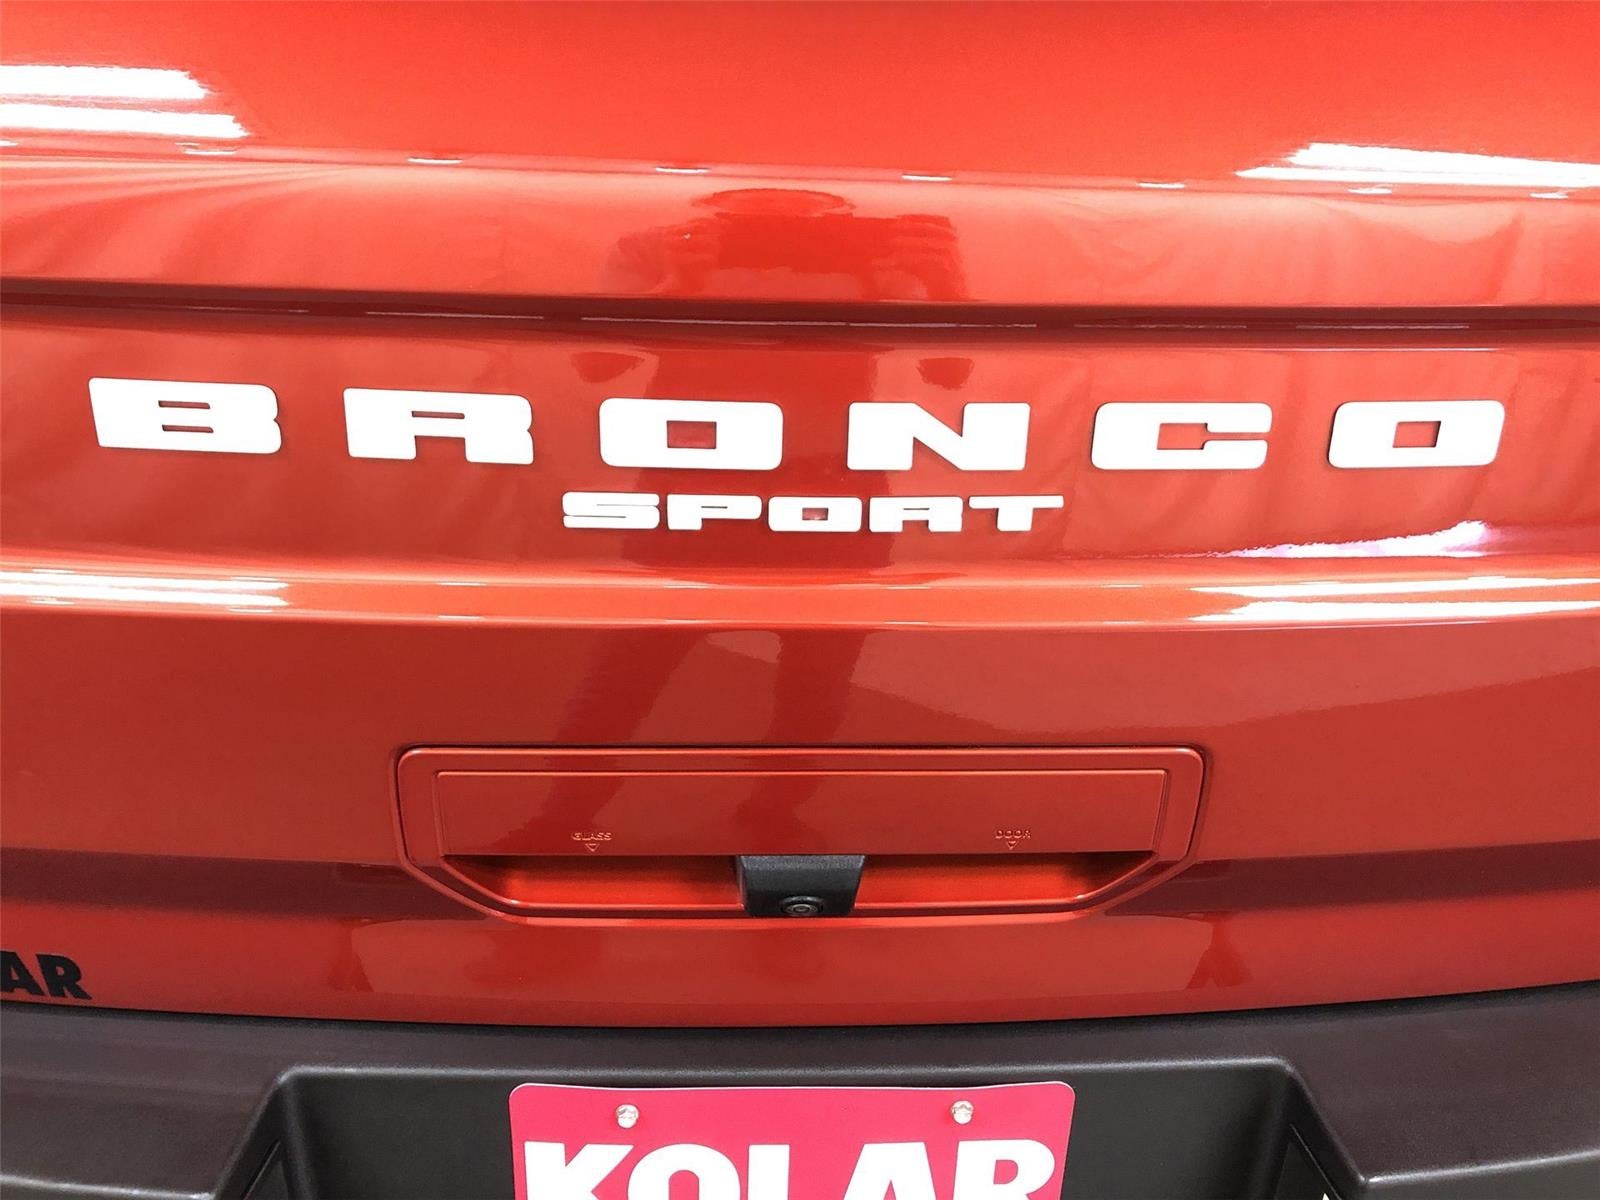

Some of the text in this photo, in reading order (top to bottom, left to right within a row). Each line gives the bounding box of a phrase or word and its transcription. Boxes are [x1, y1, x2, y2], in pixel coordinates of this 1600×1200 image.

[88, 377, 1506, 471] BRONCO
[562, 491, 1064, 533] SPORT
[571, 831, 613, 841] GLASS
[994, 829, 1031, 840] DOOR
